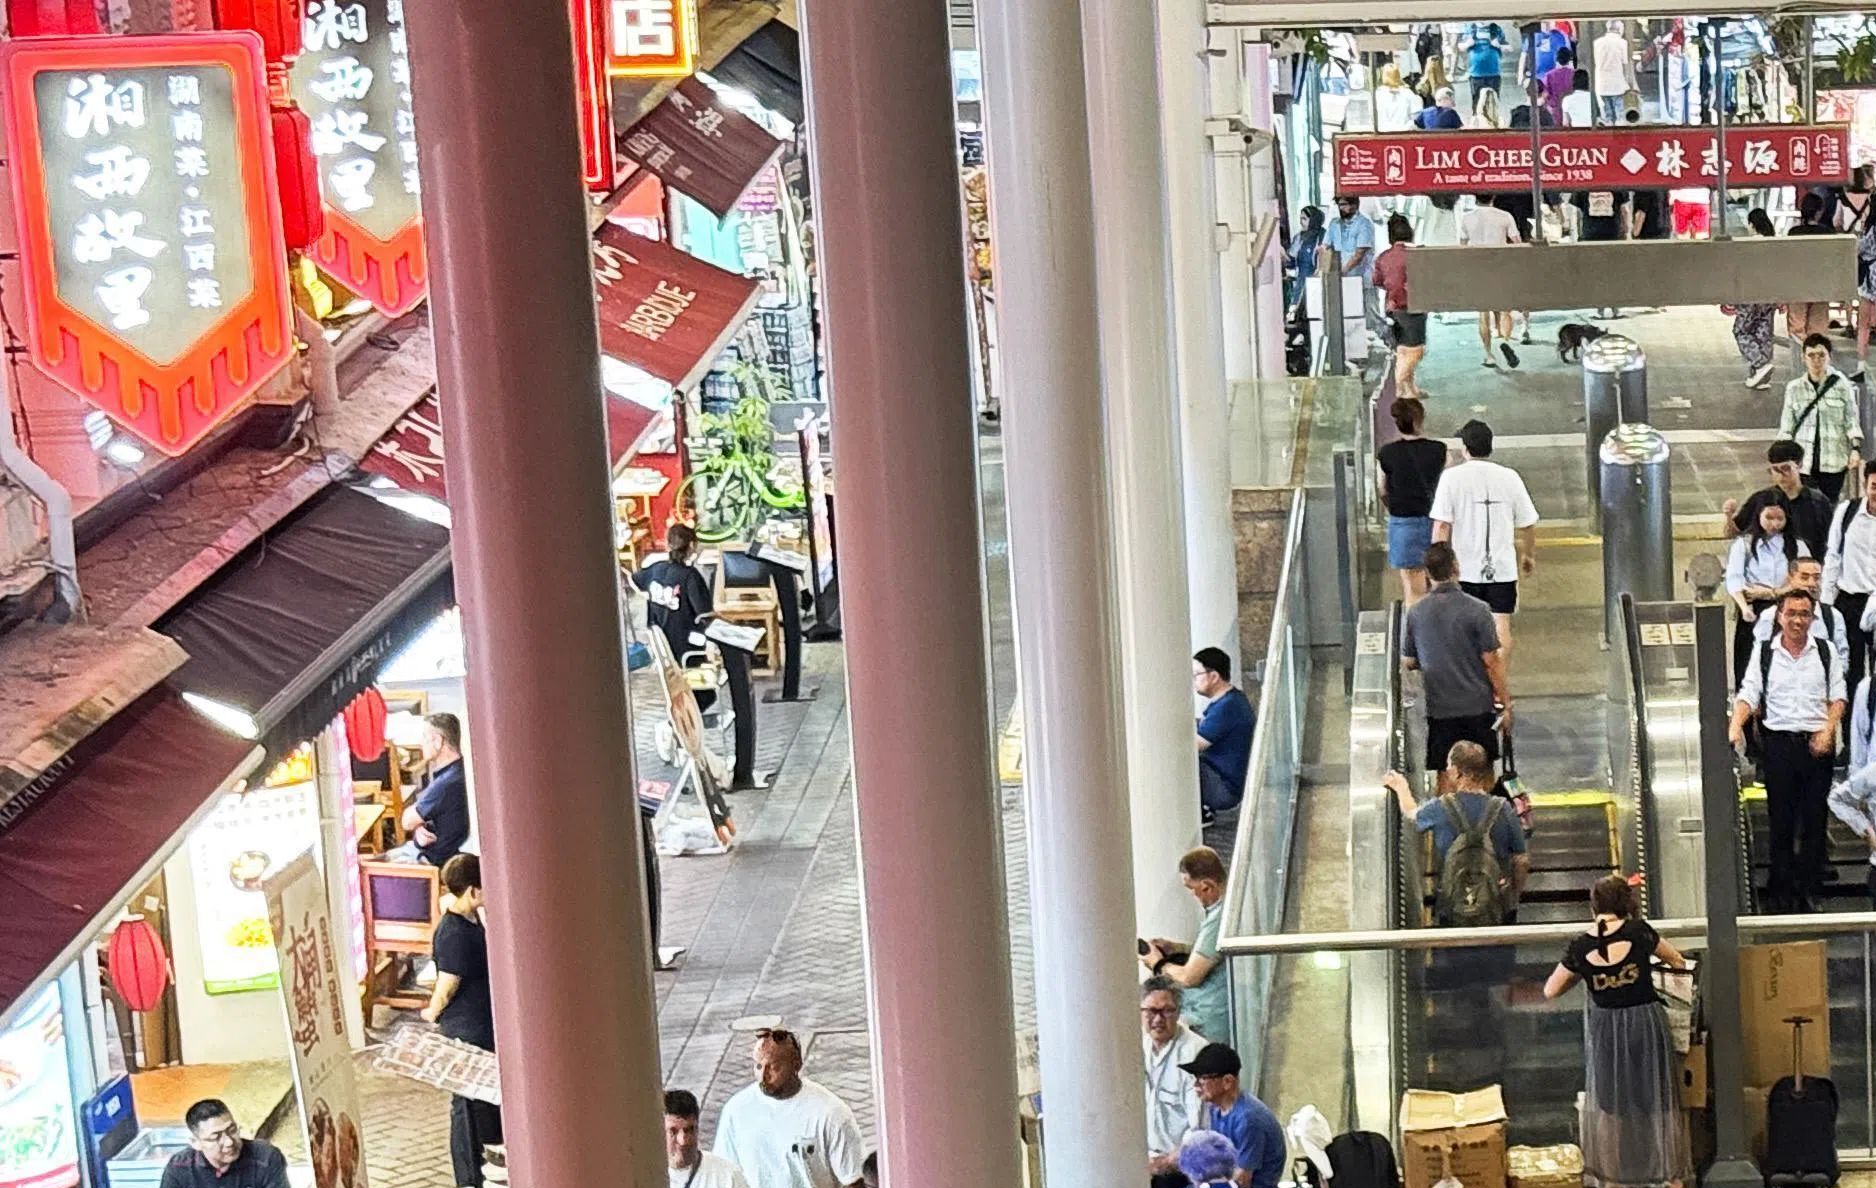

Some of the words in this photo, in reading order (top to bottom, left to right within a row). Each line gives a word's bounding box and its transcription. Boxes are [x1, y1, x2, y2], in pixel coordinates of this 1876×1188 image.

[303, 0, 387, 211] 湘西故里
[1415, 146, 1460, 169] LIM
[1467, 144, 1533, 169] CHEE
[1539, 143, 1608, 167] GUAN
[1433, 172, 1444, 184] A
[1471, 171, 1483, 184] of
[1566, 169, 1593, 181] 1938
[1655, 137, 1780, 178] 林志源
[64, 74, 168, 330] 湘西故里
